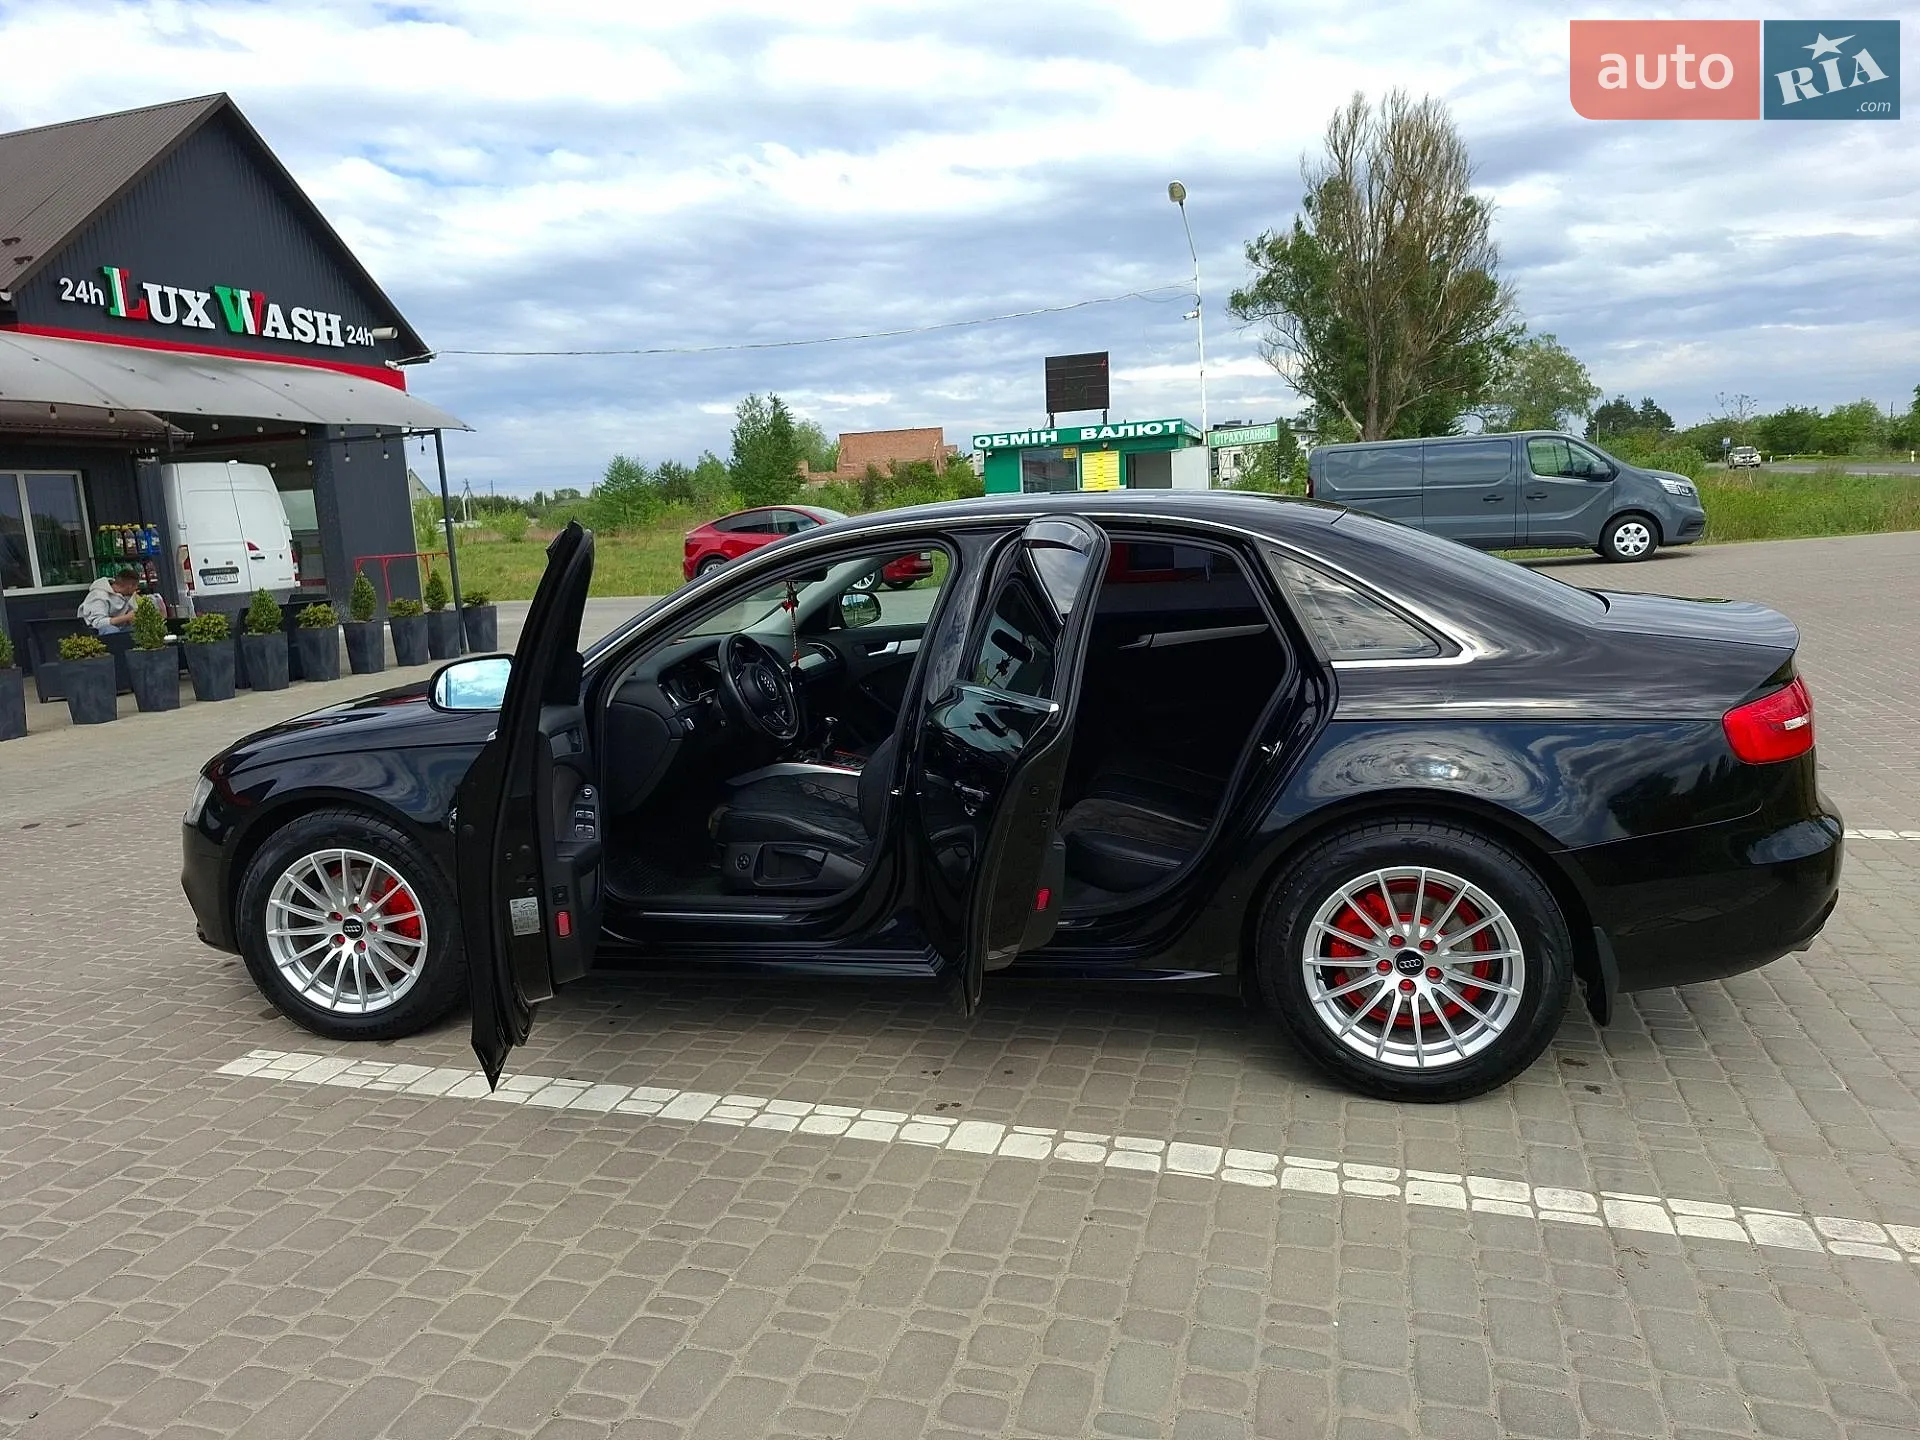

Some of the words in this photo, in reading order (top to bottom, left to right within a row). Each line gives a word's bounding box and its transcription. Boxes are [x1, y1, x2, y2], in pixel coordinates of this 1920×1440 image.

[59, 277, 105, 306] 24h
[345, 325, 375, 347] 24h
[973, 430, 1059, 448] ОБМІН
[1080, 421, 1182, 441] ВАЛЮТ
